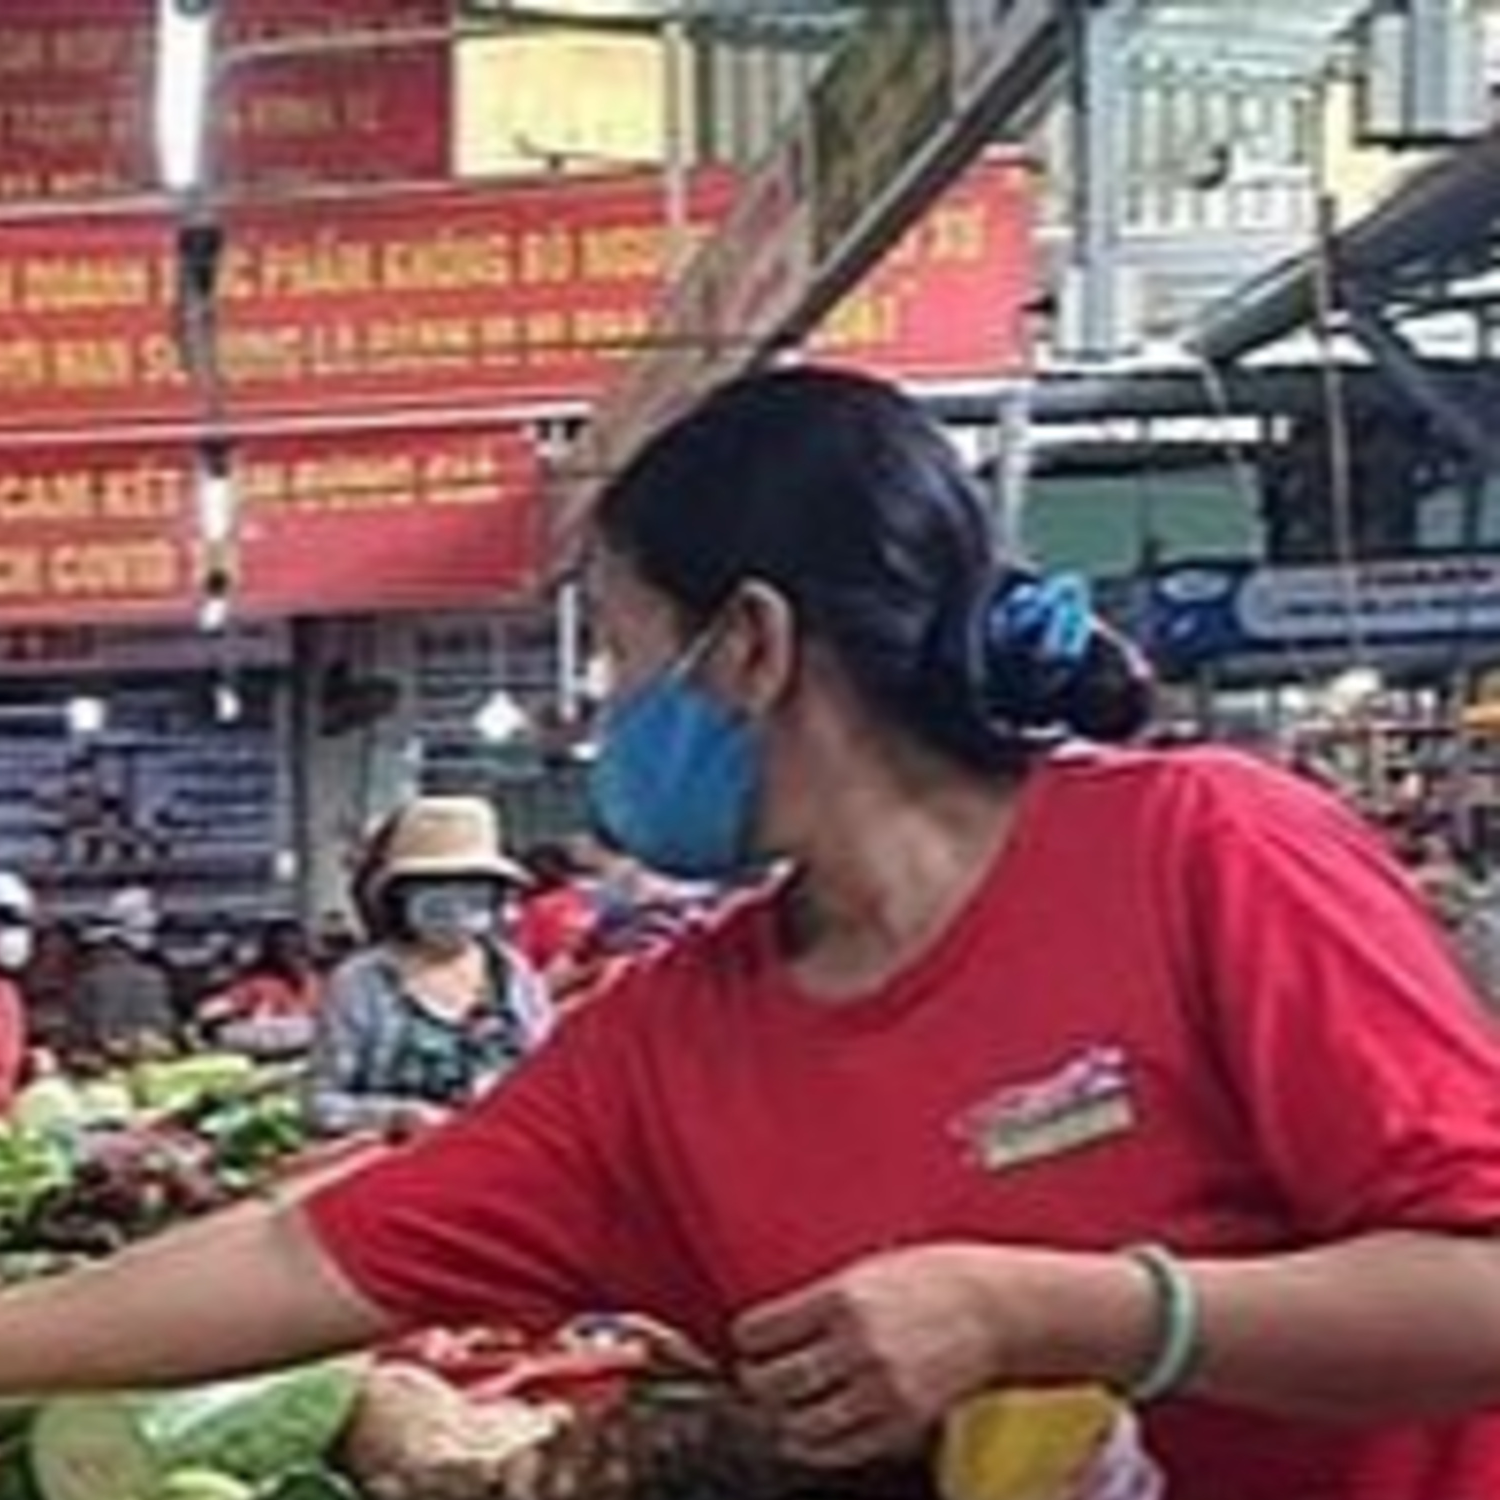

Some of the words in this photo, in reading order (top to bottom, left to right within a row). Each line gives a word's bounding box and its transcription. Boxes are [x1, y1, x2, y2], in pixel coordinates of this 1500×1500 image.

[23, 255, 150, 312] DOANH
[382, 224, 509, 287] KHÔNG
[106, 455, 183, 518] KẾT
[52, 536, 179, 593] COVID
